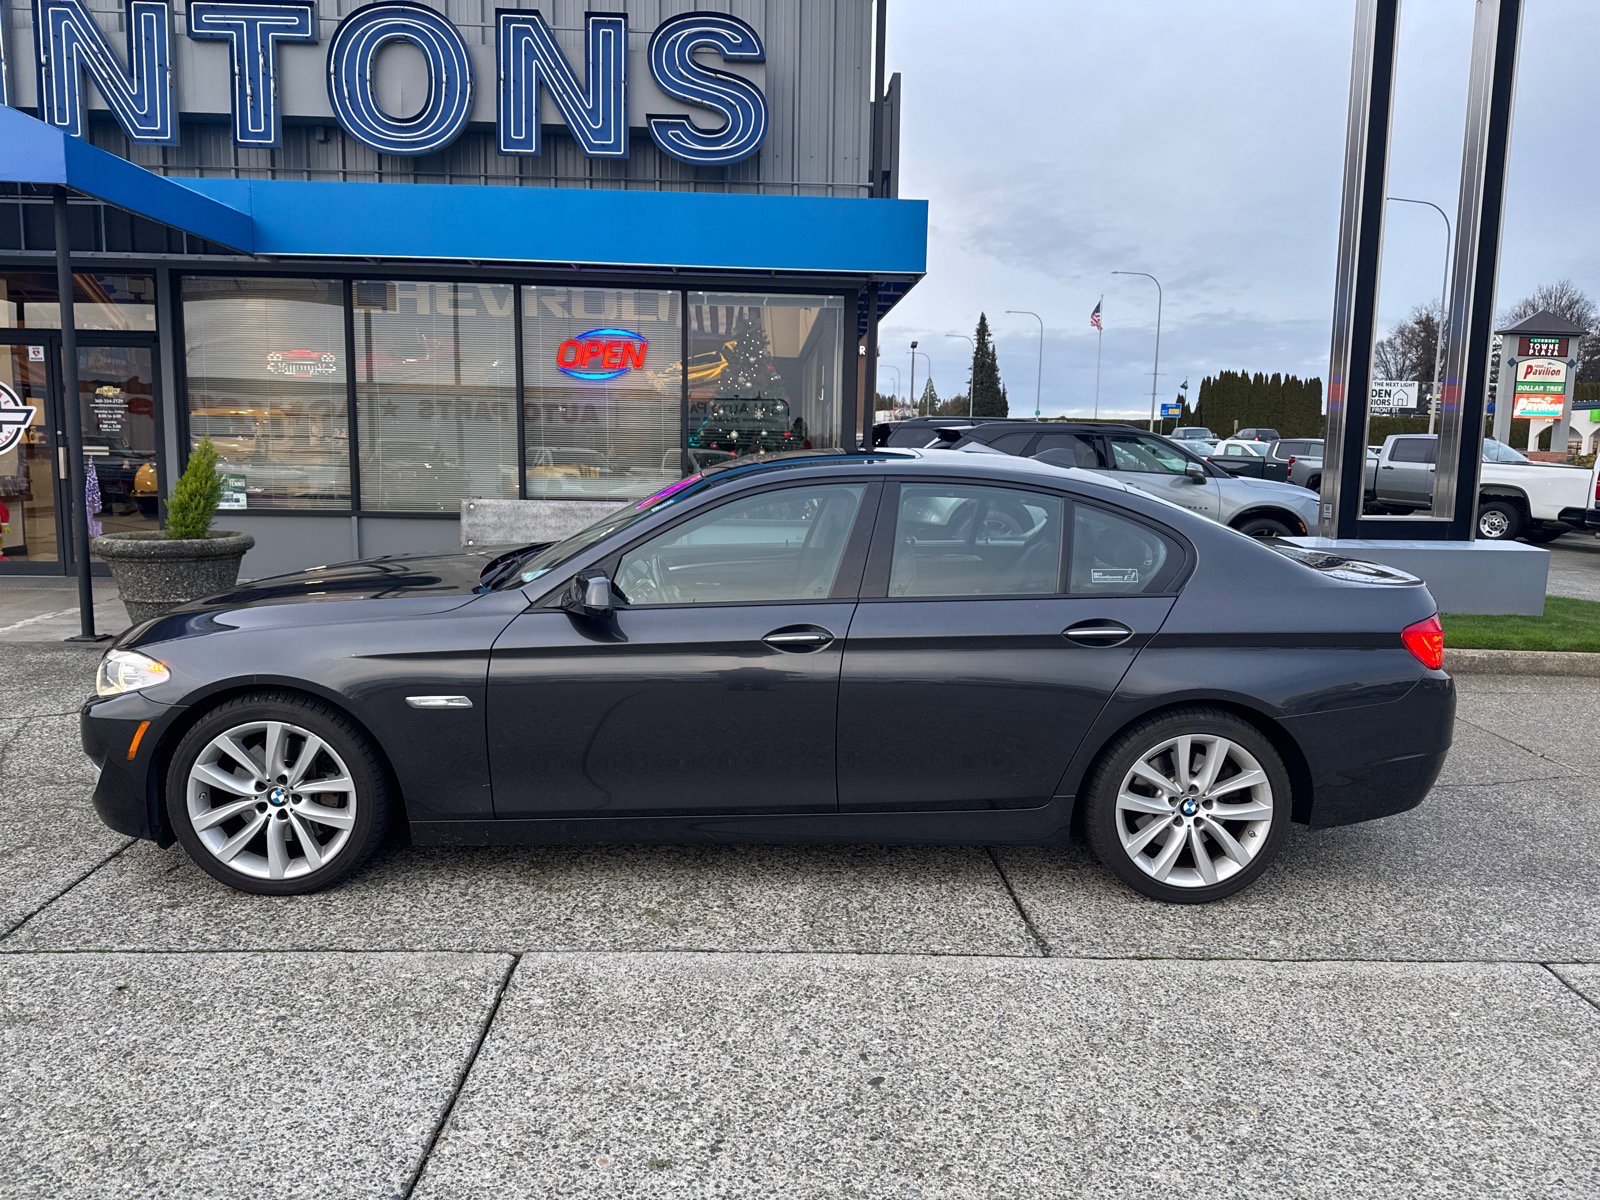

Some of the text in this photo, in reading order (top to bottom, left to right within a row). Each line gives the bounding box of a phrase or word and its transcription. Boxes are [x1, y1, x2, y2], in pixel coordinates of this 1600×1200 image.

[0, 0, 767, 166] NTONS
[555, 339, 649, 370] OPEN
[1523, 364, 1561, 380] Pavilion
[1370, 398, 1391, 406] RIORS
[1371, 389, 1392, 399] DEN
